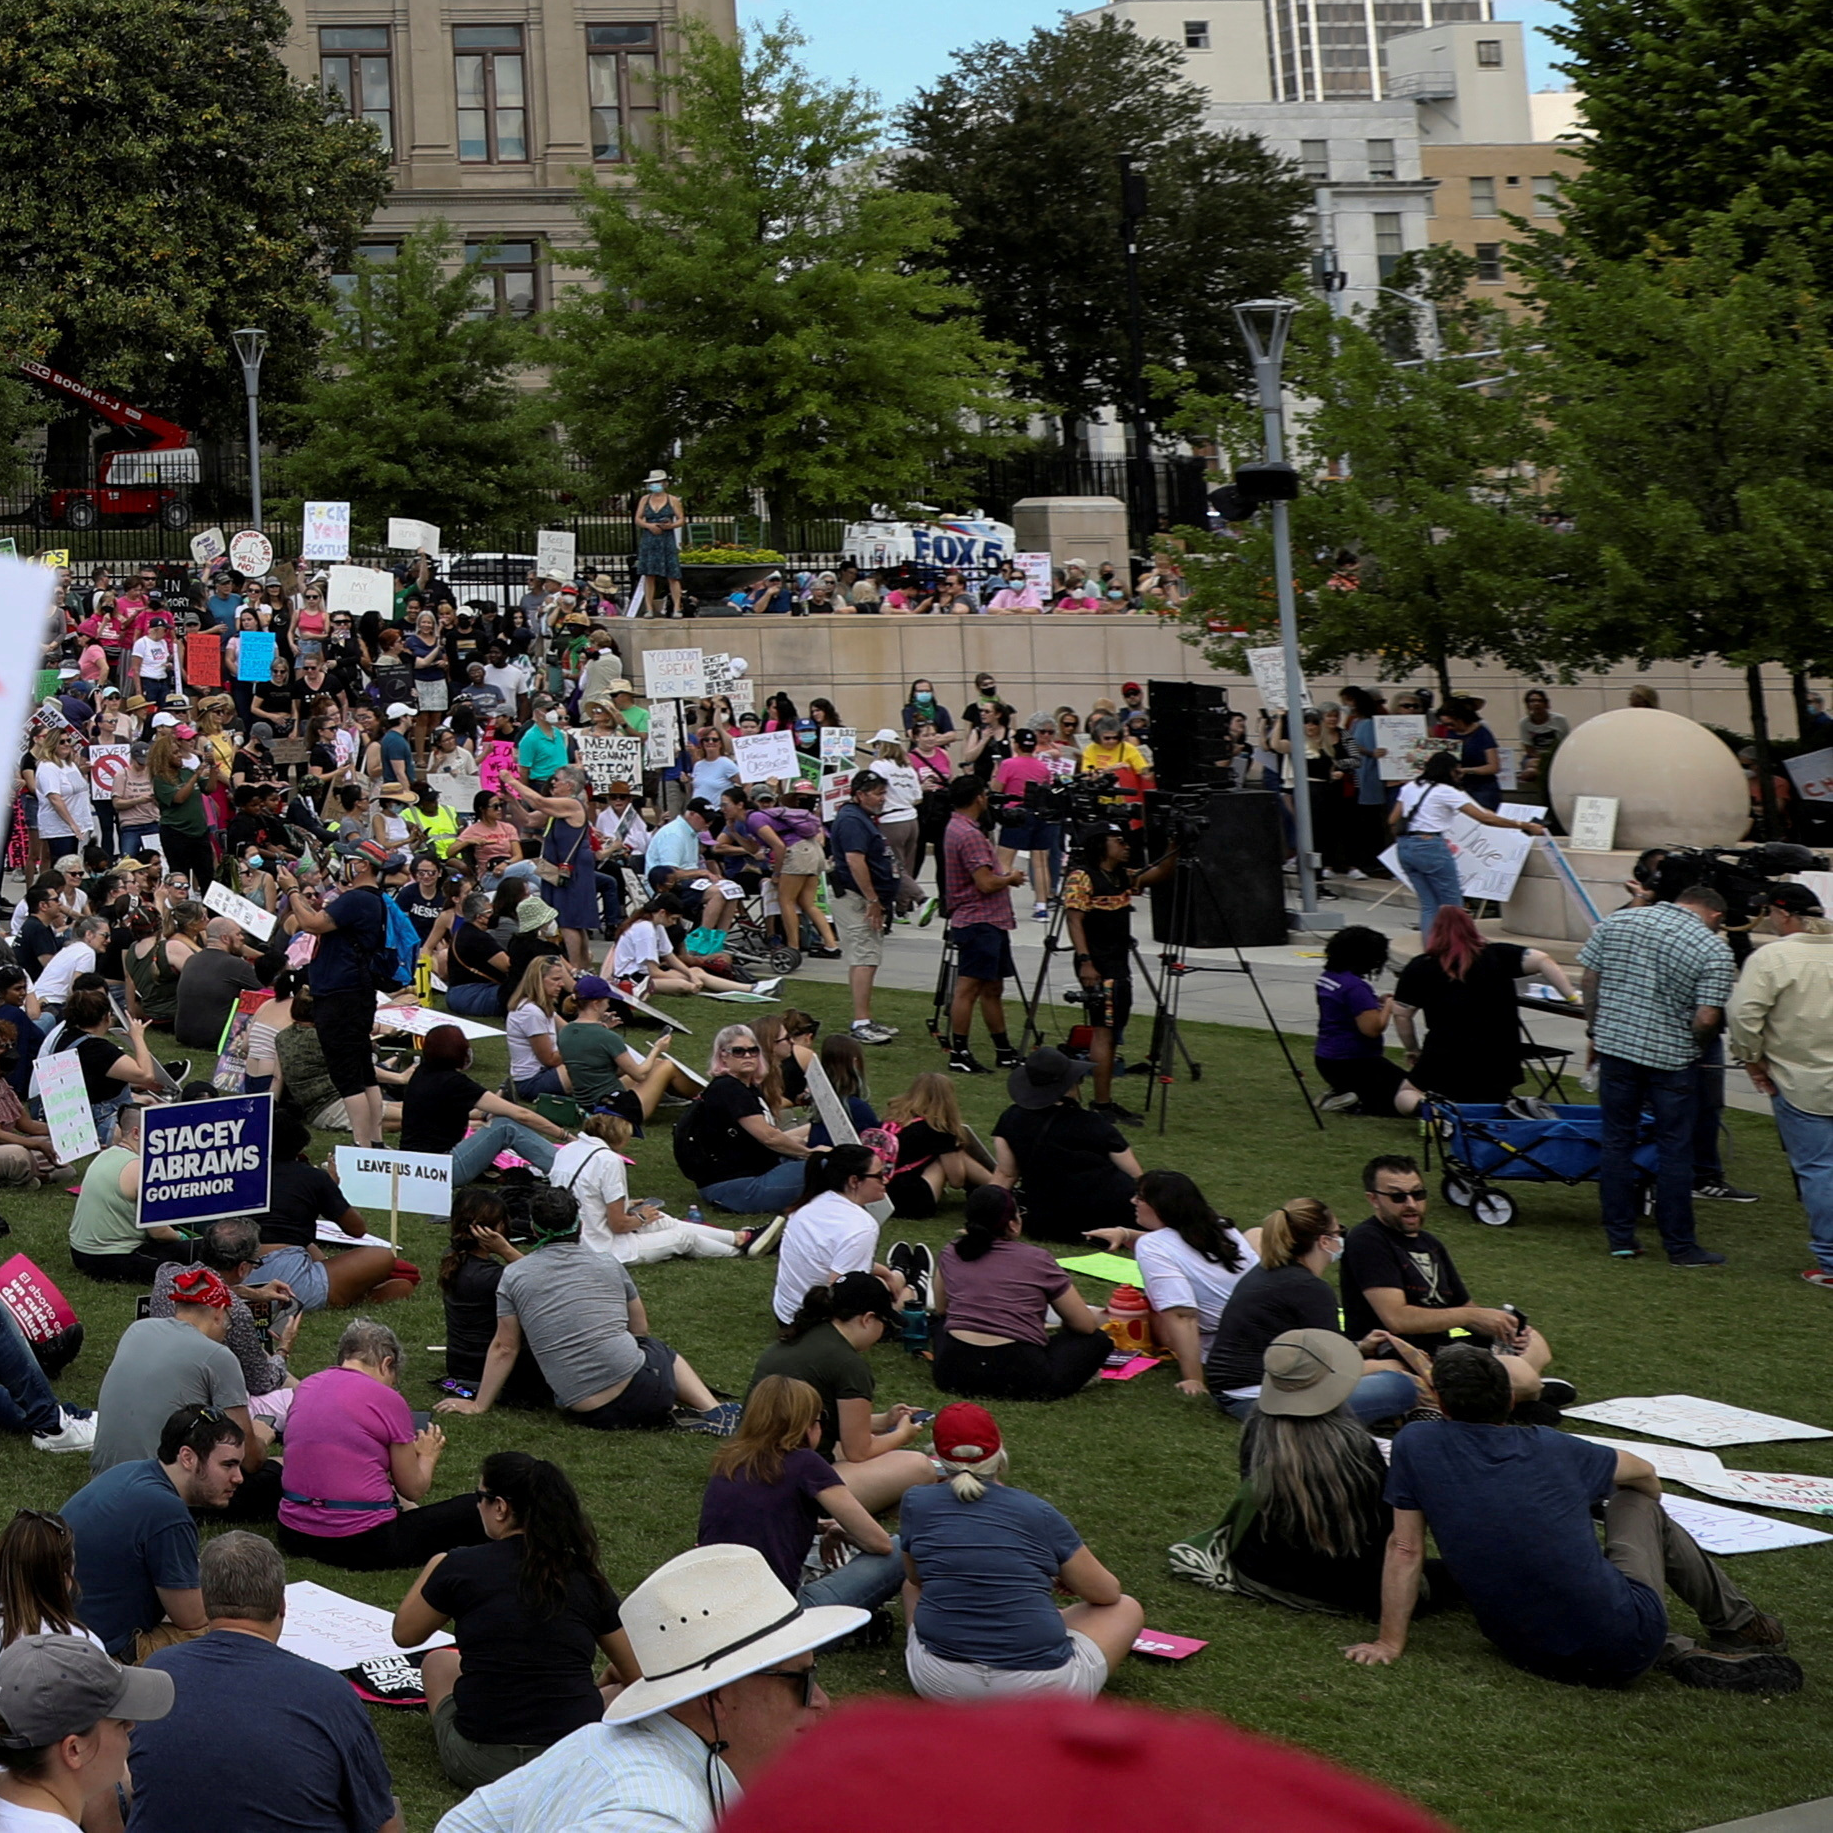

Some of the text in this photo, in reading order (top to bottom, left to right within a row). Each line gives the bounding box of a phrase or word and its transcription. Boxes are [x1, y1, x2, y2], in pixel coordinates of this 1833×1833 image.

[305, 543, 348, 556] SCOTUS
[914, 529, 1004, 569] FOX 5
[164, 579, 180, 593] IN
[654, 680, 676, 693] FOR
[584, 737, 641, 751] MEN GOT
[148, 1118, 246, 1155] STACEY
[146, 1145, 260, 1183] ABRAMS
[357, 1159, 392, 1174] LEAVE
[397, 1163, 411, 1176] US
[145, 1178, 234, 1203] GOVERNOR
[10, 1278, 26, 1298] un
[18, 1271, 56, 1320] El aborto
[1, 1285, 41, 1341] de salud.
